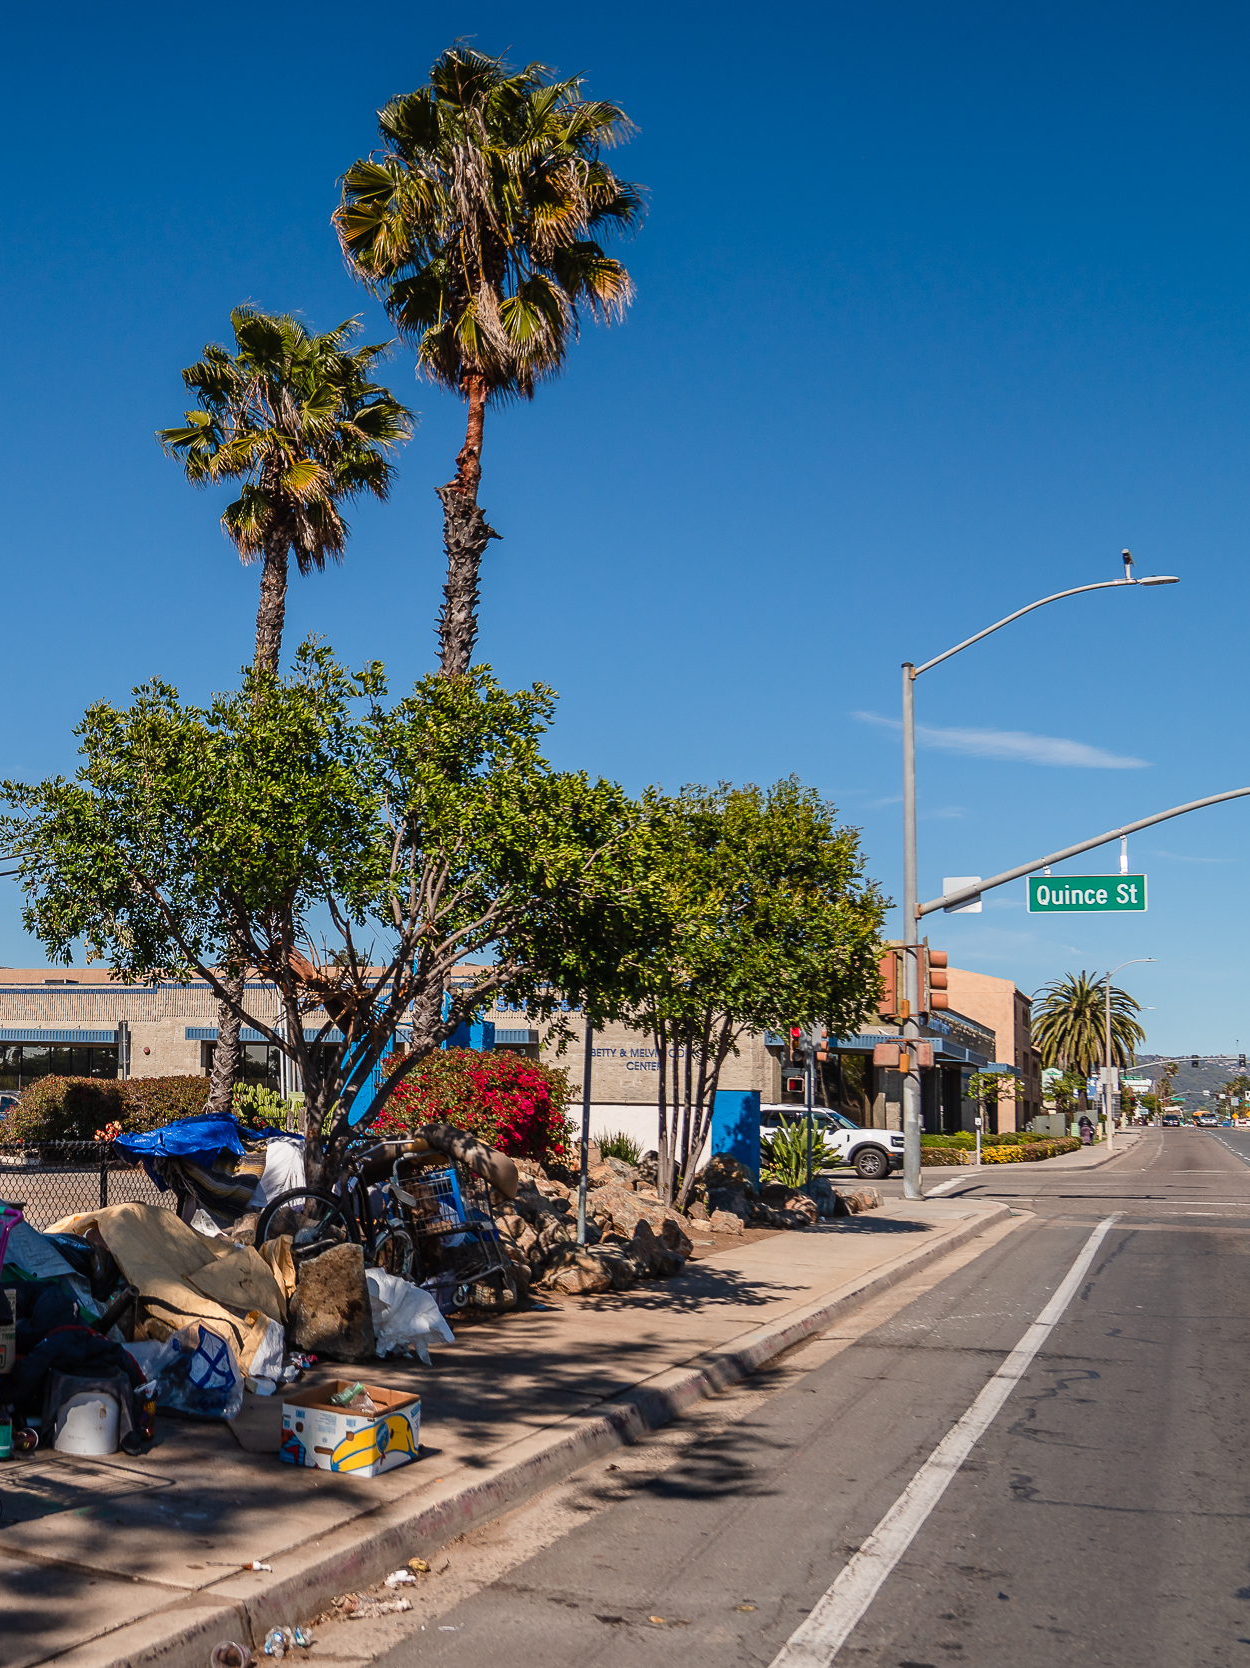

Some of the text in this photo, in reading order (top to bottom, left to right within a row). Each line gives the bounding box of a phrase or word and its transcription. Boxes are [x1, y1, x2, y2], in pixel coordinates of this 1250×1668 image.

[1036, 883, 1138, 906] Quince St
[591, 1048, 617, 1057] BETTY
[619, 1048, 627, 1057] &
[630, 1048, 659, 1057] MELVI
